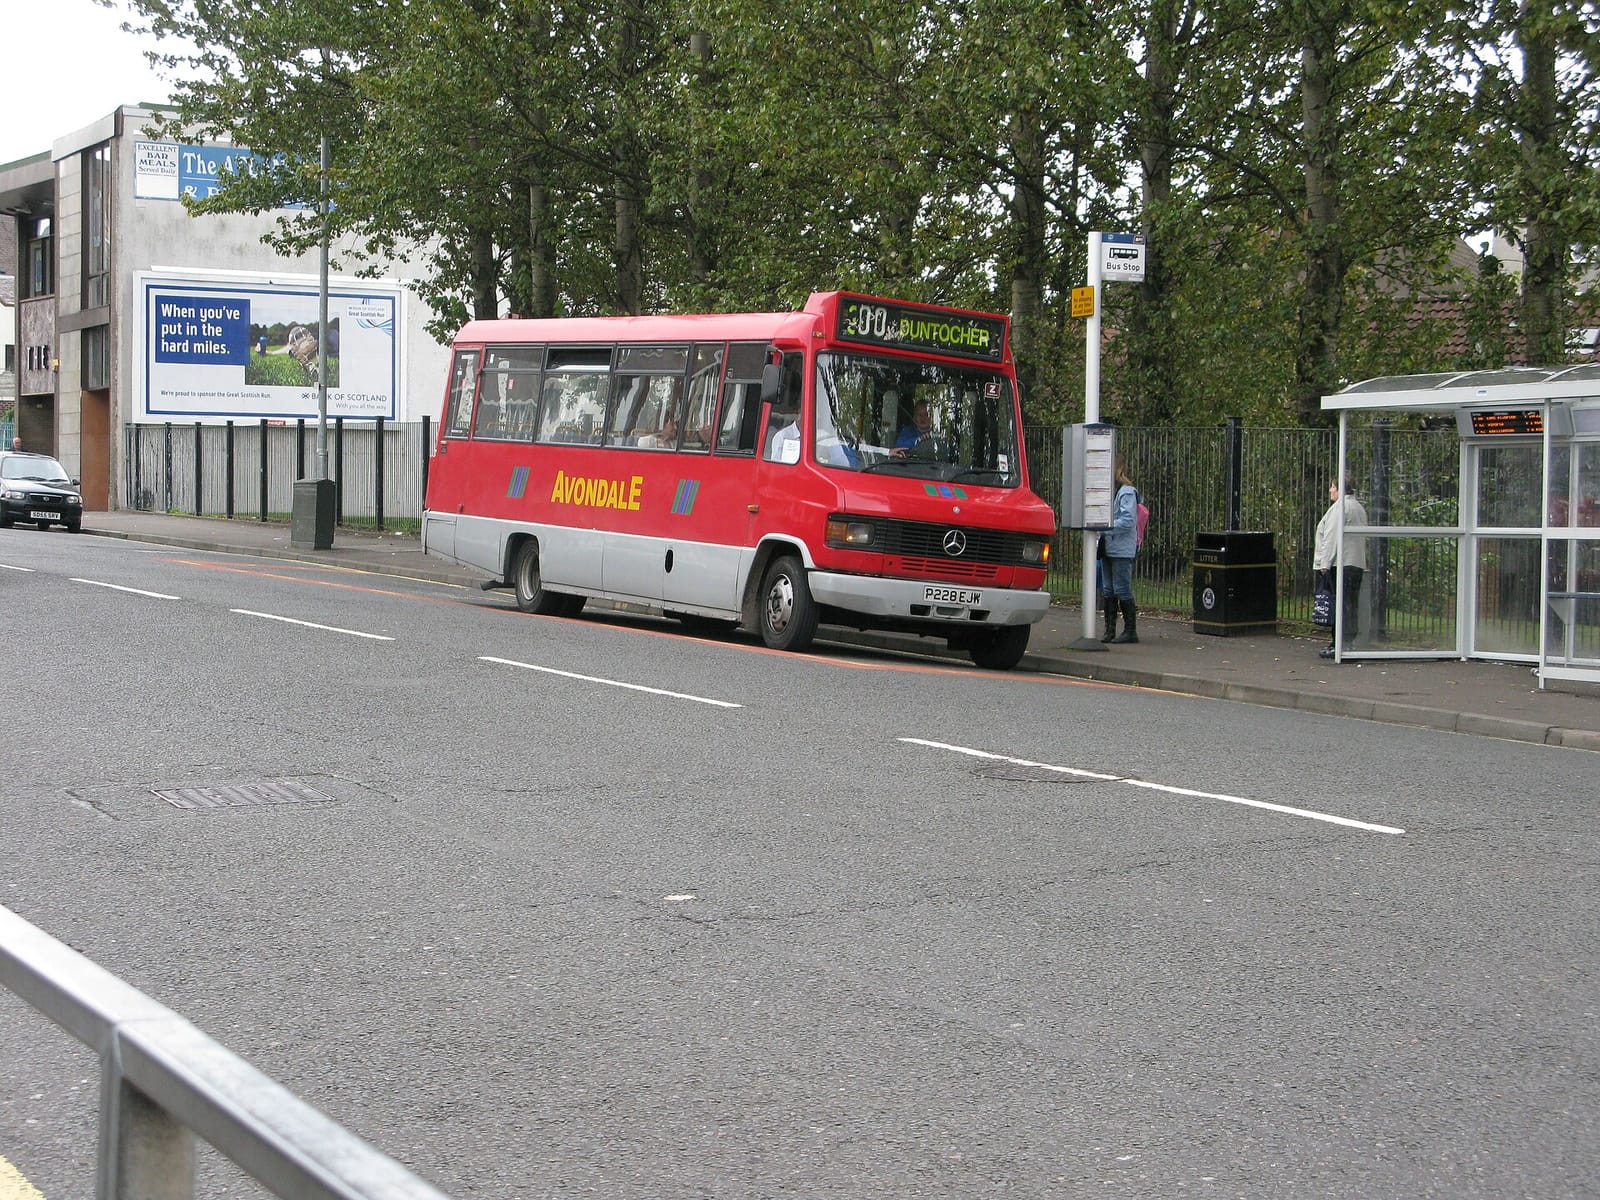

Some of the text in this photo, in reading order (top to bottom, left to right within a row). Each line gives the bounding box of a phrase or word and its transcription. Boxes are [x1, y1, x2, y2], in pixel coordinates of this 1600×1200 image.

[138, 144, 177, 152] EXCELLENT
[139, 159, 176, 167] MEALS
[182, 152, 217, 175] The
[1106, 262, 1140, 272] Bus Stop
[161, 303, 240, 322] When you've
[161, 322, 223, 338] put in the
[900, 319, 990, 347] DUNTOCHER
[161, 339, 231, 355] hard miles.
[27, 345, 48, 370] THE
[347, 394, 387, 402] SCOTLAND
[550, 470, 644, 511] AVONDALE
[1199, 554, 1218, 563] LITTER
[925, 588, 981, 604] P228 EJW
